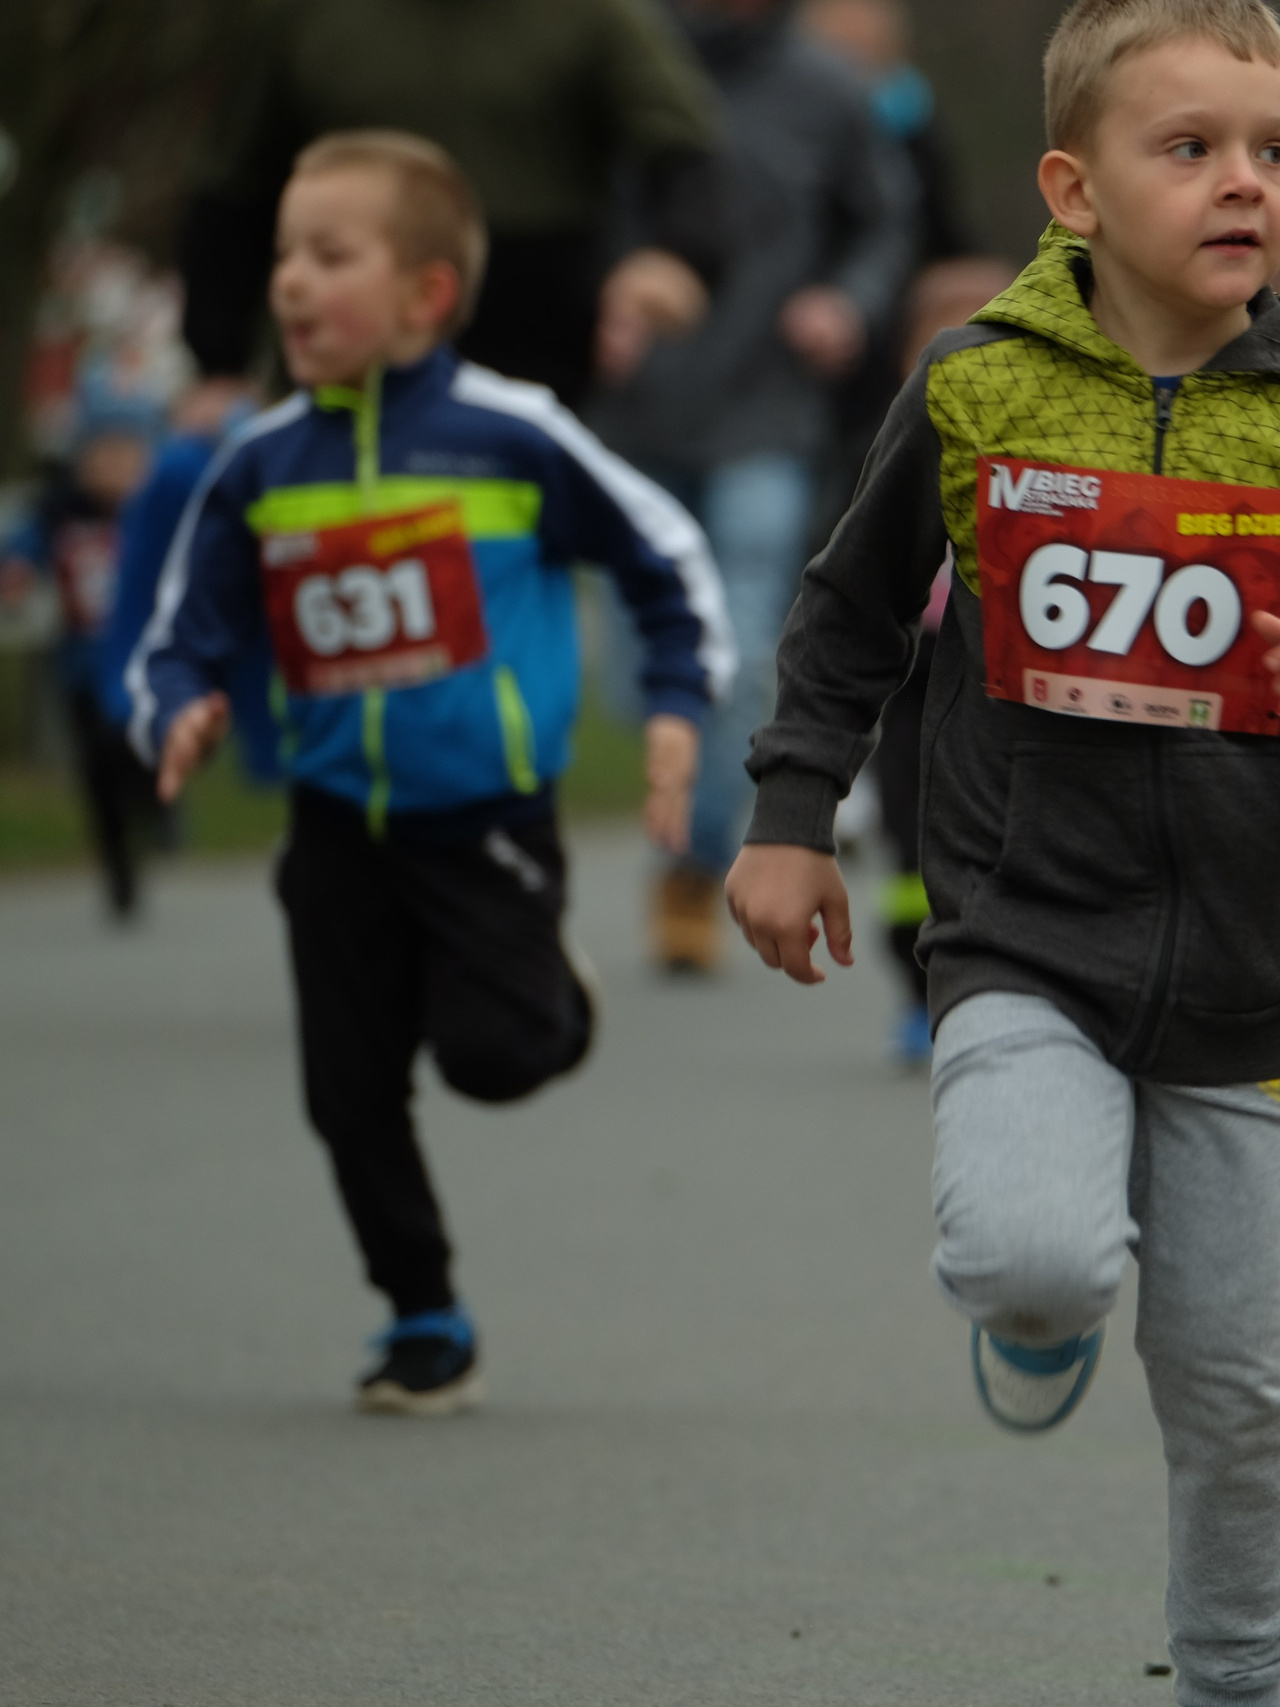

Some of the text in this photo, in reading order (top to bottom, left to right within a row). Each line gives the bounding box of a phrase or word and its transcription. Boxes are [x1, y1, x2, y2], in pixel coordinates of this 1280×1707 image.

[1034, 470, 1101, 498] BIEG
[295, 558, 435, 655] 631
[1019, 543, 1241, 667] 670
